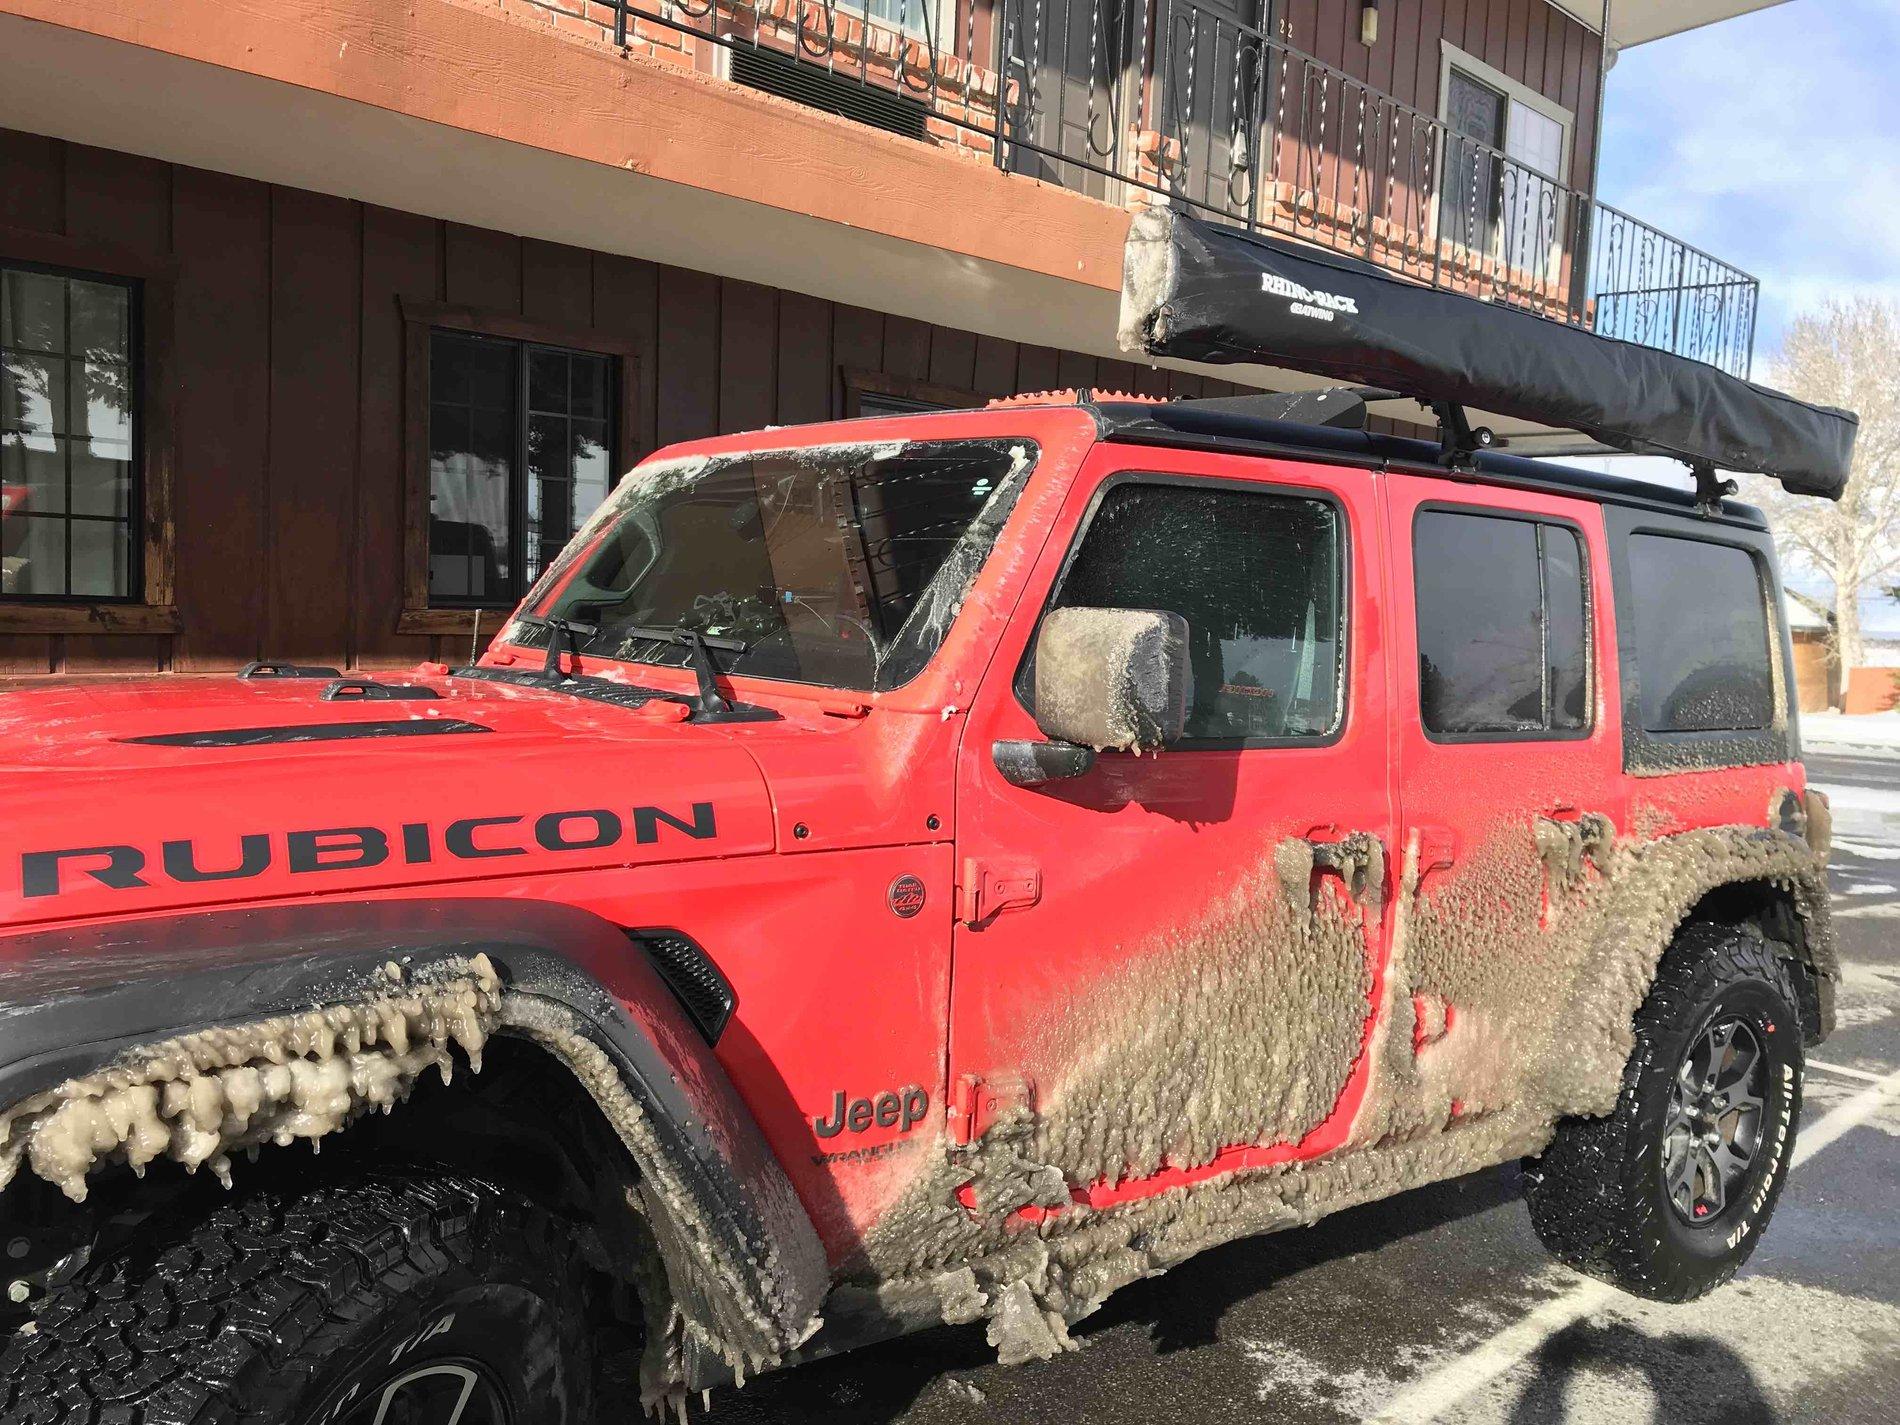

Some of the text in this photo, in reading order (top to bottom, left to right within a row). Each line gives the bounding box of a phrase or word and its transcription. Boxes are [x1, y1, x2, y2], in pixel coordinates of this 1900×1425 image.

[1279, 18, 1293, 39] 22
[1261, 272, 1359, 314] RHINO-RACK
[21, 802, 717, 898] RUBICON
[813, 1083, 929, 1138] Jeep
[1752, 1063, 1794, 1214] All-Terrain
